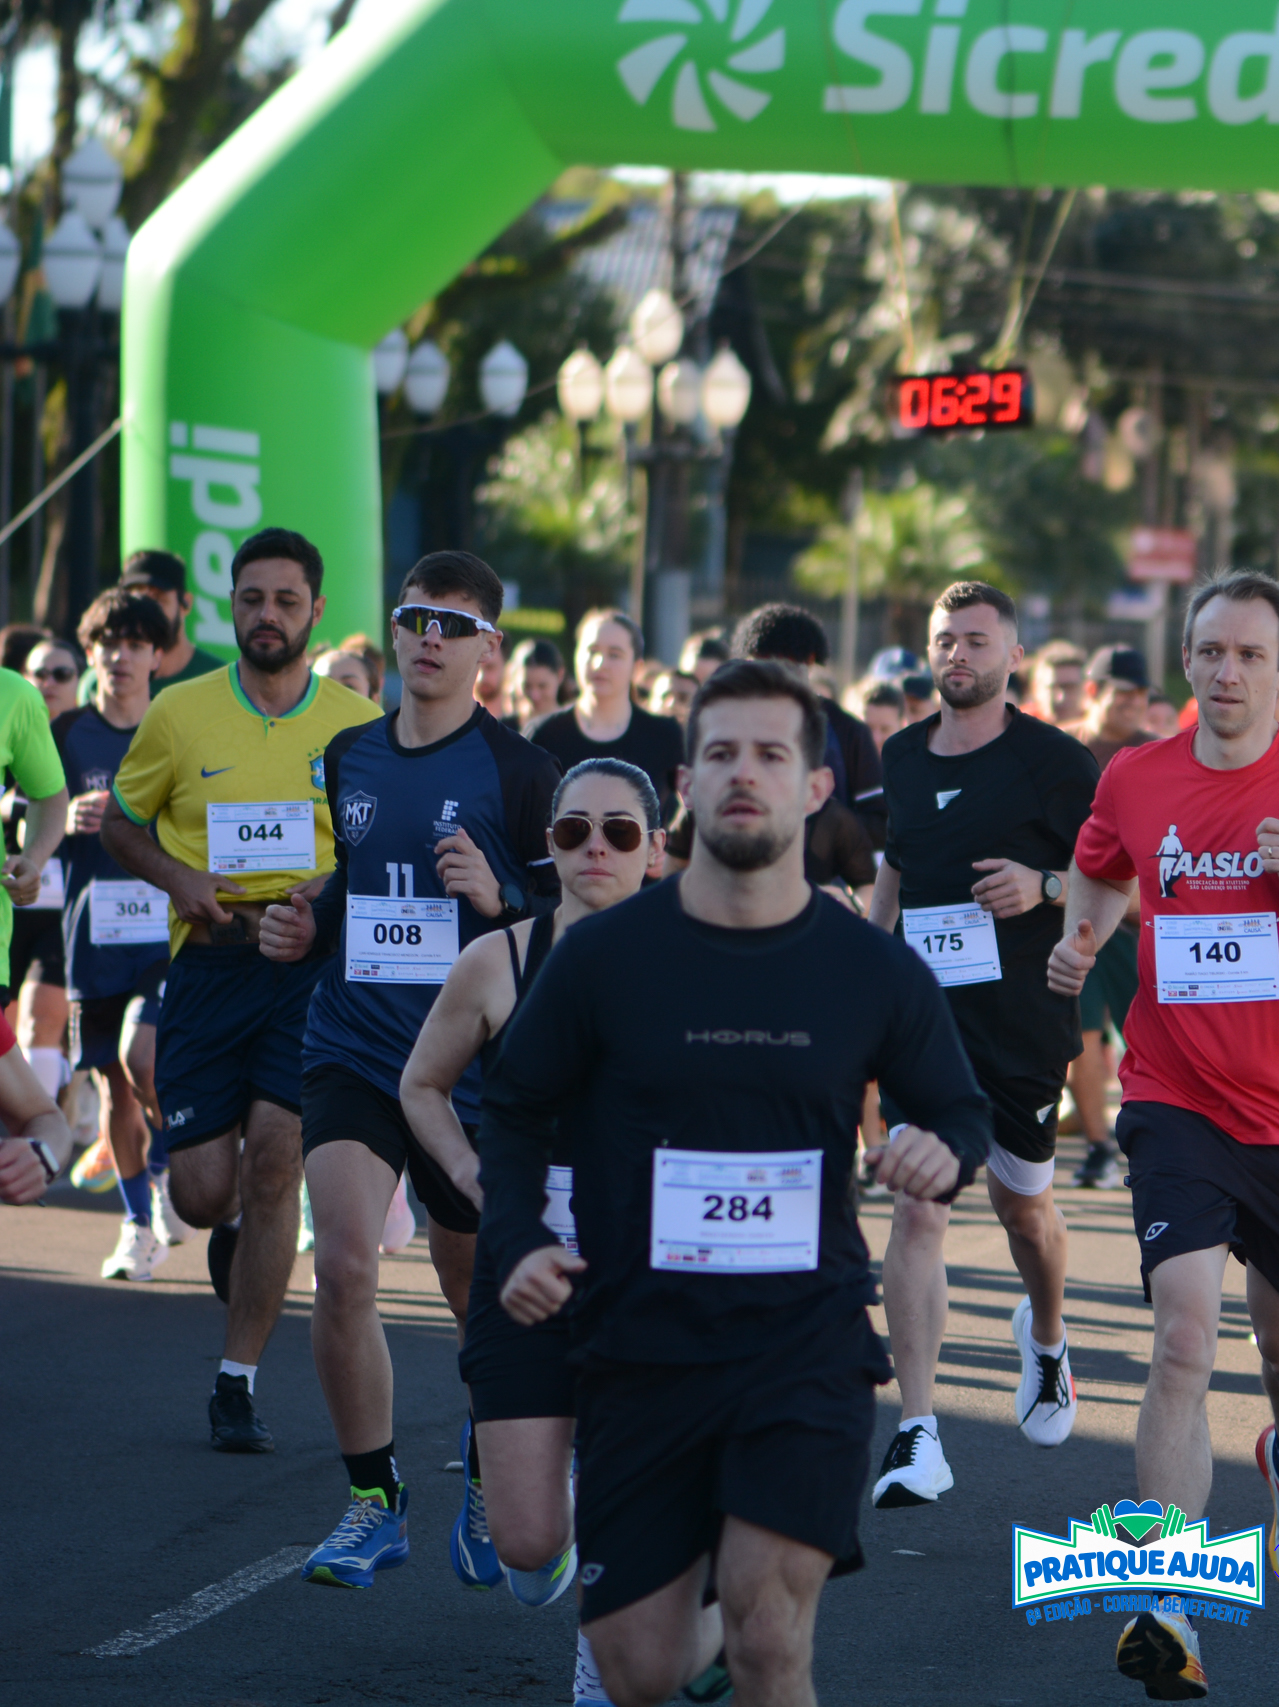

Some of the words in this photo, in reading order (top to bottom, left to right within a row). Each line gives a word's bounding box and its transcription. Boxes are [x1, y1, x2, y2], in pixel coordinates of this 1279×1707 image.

[345, 802, 372, 826] MKT
[238, 823, 284, 842] 044
[1172, 851, 1265, 878] AASLO
[386, 862, 414, 897] 11
[116, 902, 151, 916] 304
[373, 923, 422, 945] 008
[923, 932, 964, 954] 175
[1189, 941, 1241, 963] 140
[685, 1030, 811, 1046] HORUS
[703, 1194, 774, 1222] 284
